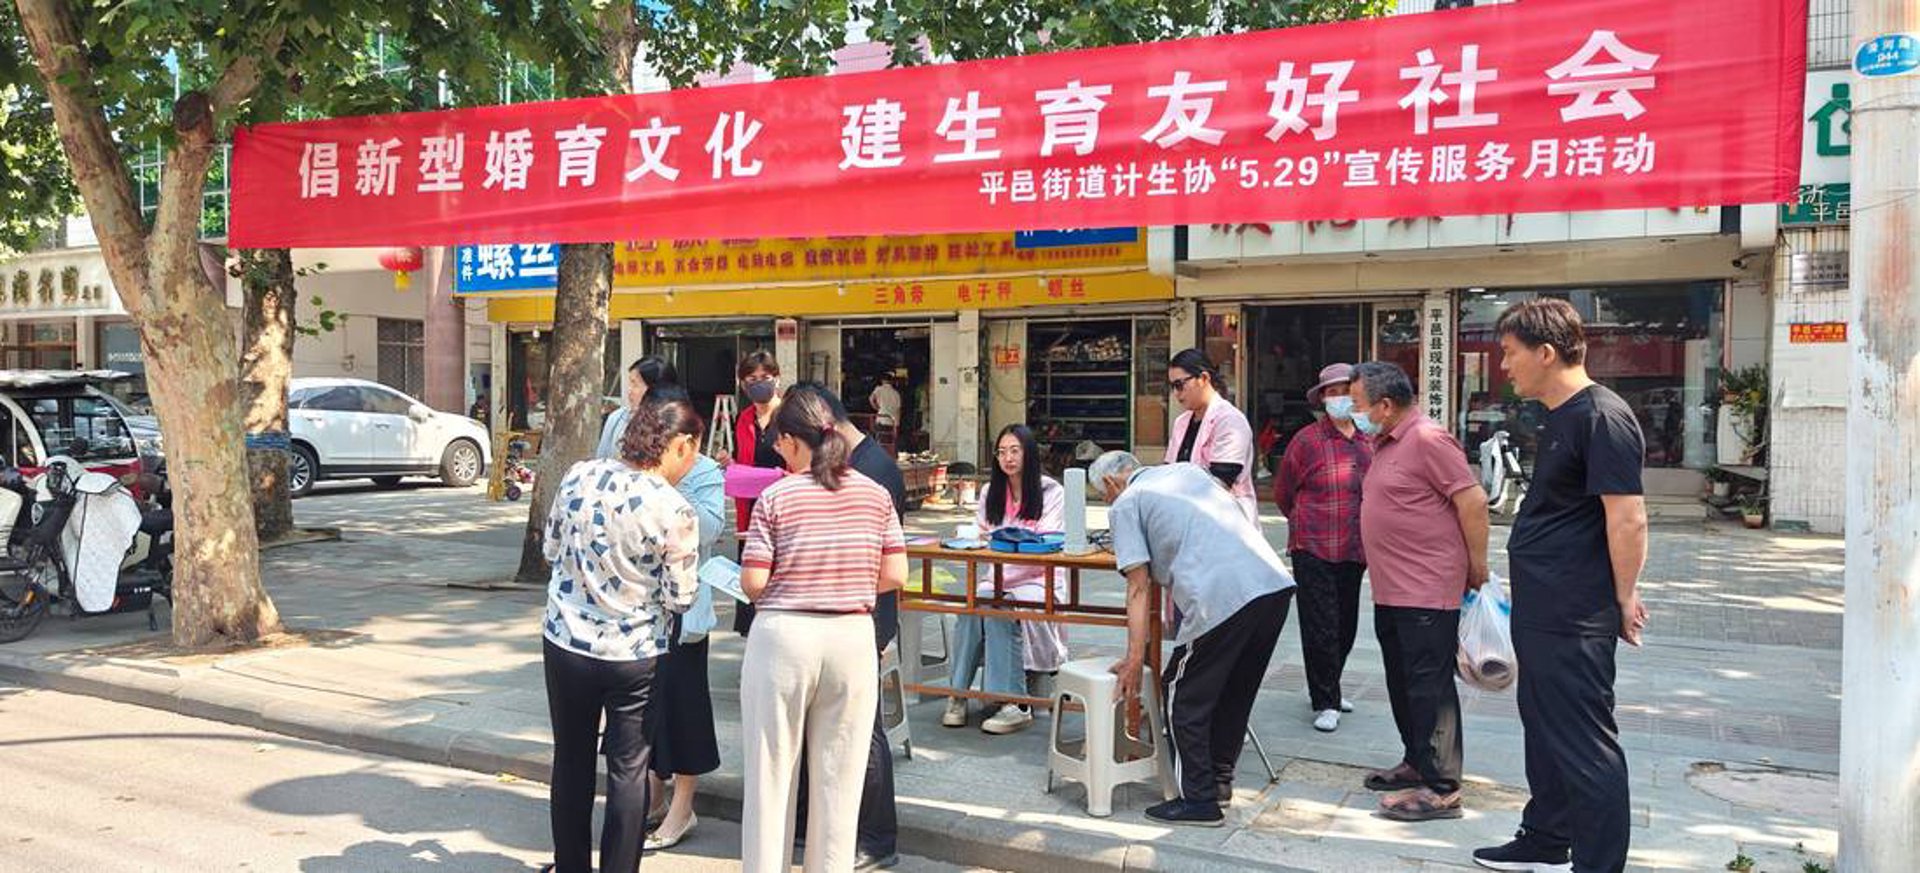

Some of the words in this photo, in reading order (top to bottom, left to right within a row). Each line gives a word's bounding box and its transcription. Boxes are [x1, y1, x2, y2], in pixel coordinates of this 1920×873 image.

[298, 110, 765, 200] 倡新型婚育文化
[838, 30, 1661, 171] 建生育友好社会
[476, 243, 559, 281] 螺丝
[957, 281, 1012, 301] 电子秤
[1048, 278, 1086, 298] 螺丝
